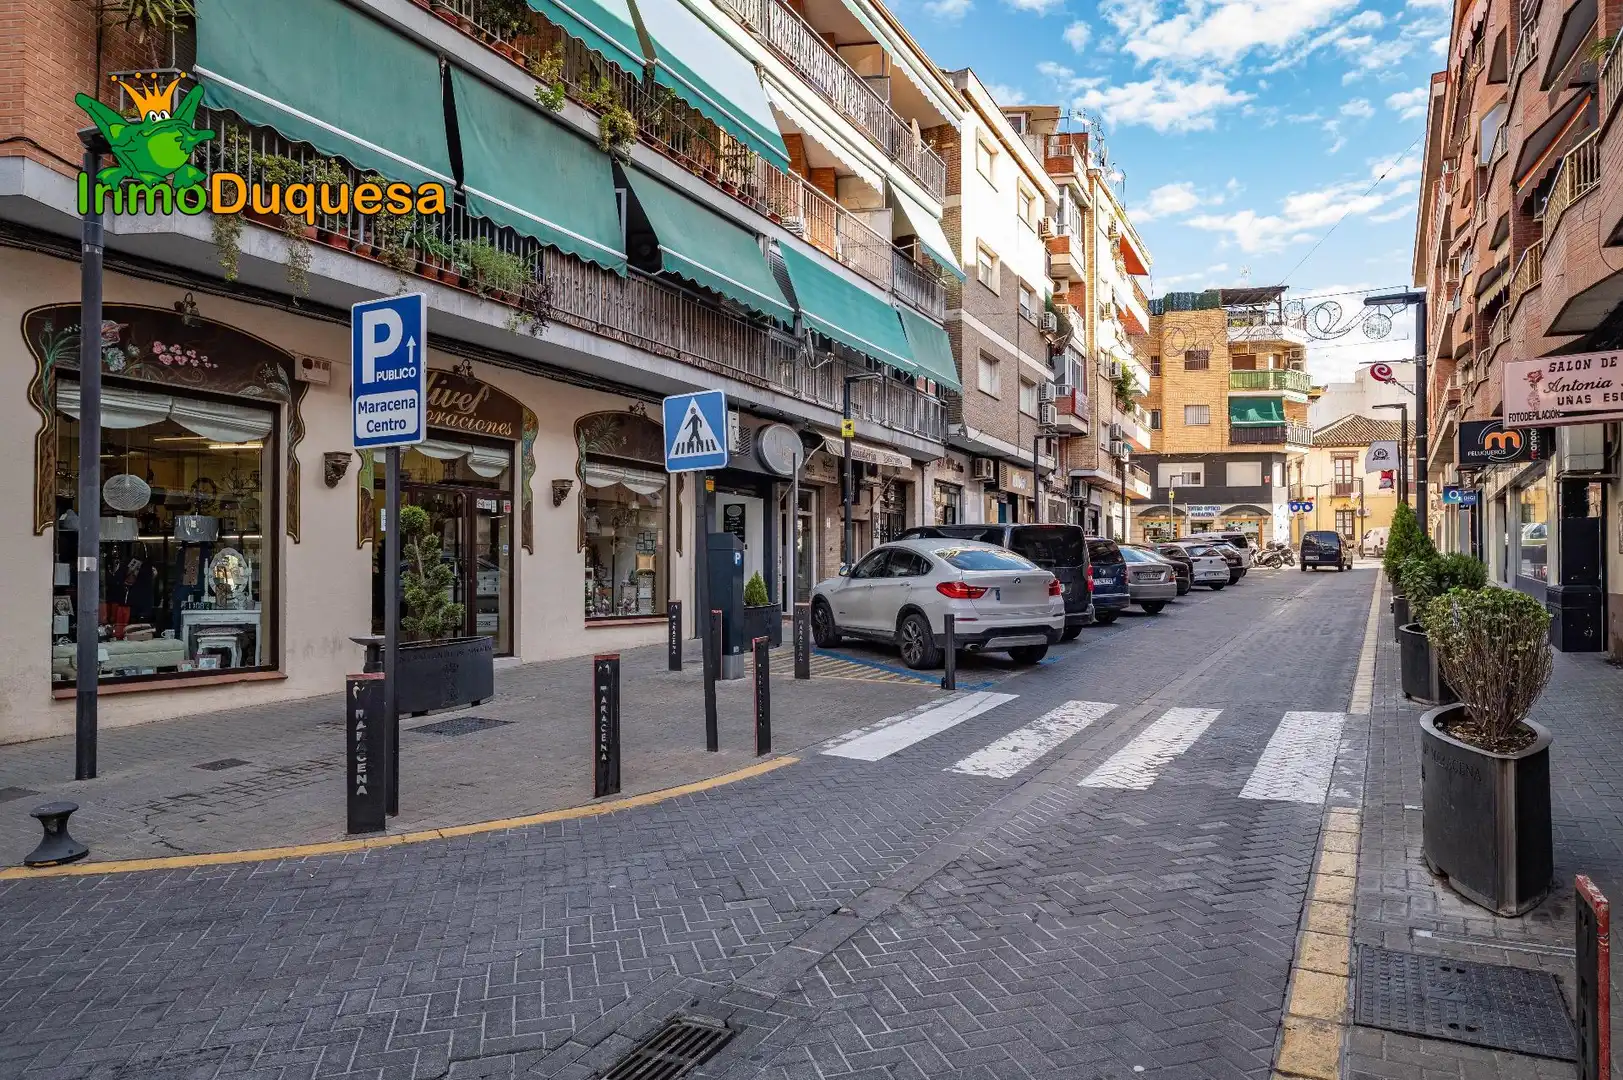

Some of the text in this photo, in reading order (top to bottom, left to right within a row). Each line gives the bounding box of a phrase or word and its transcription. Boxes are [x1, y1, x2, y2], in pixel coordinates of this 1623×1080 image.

[362, 307, 403, 384] P
[1548, 356, 1617, 372] SALON DE
[376, 366, 417, 383] PUBLICO
[1543, 377, 1613, 393] Antonia
[358, 397, 416, 414] Maracena
[1557, 394, 1591, 406] UÑAS
[366, 418, 407, 433] Centro
[426, 409, 512, 435] oraciones
[1467, 449, 1507, 457] PELUQUEROS
